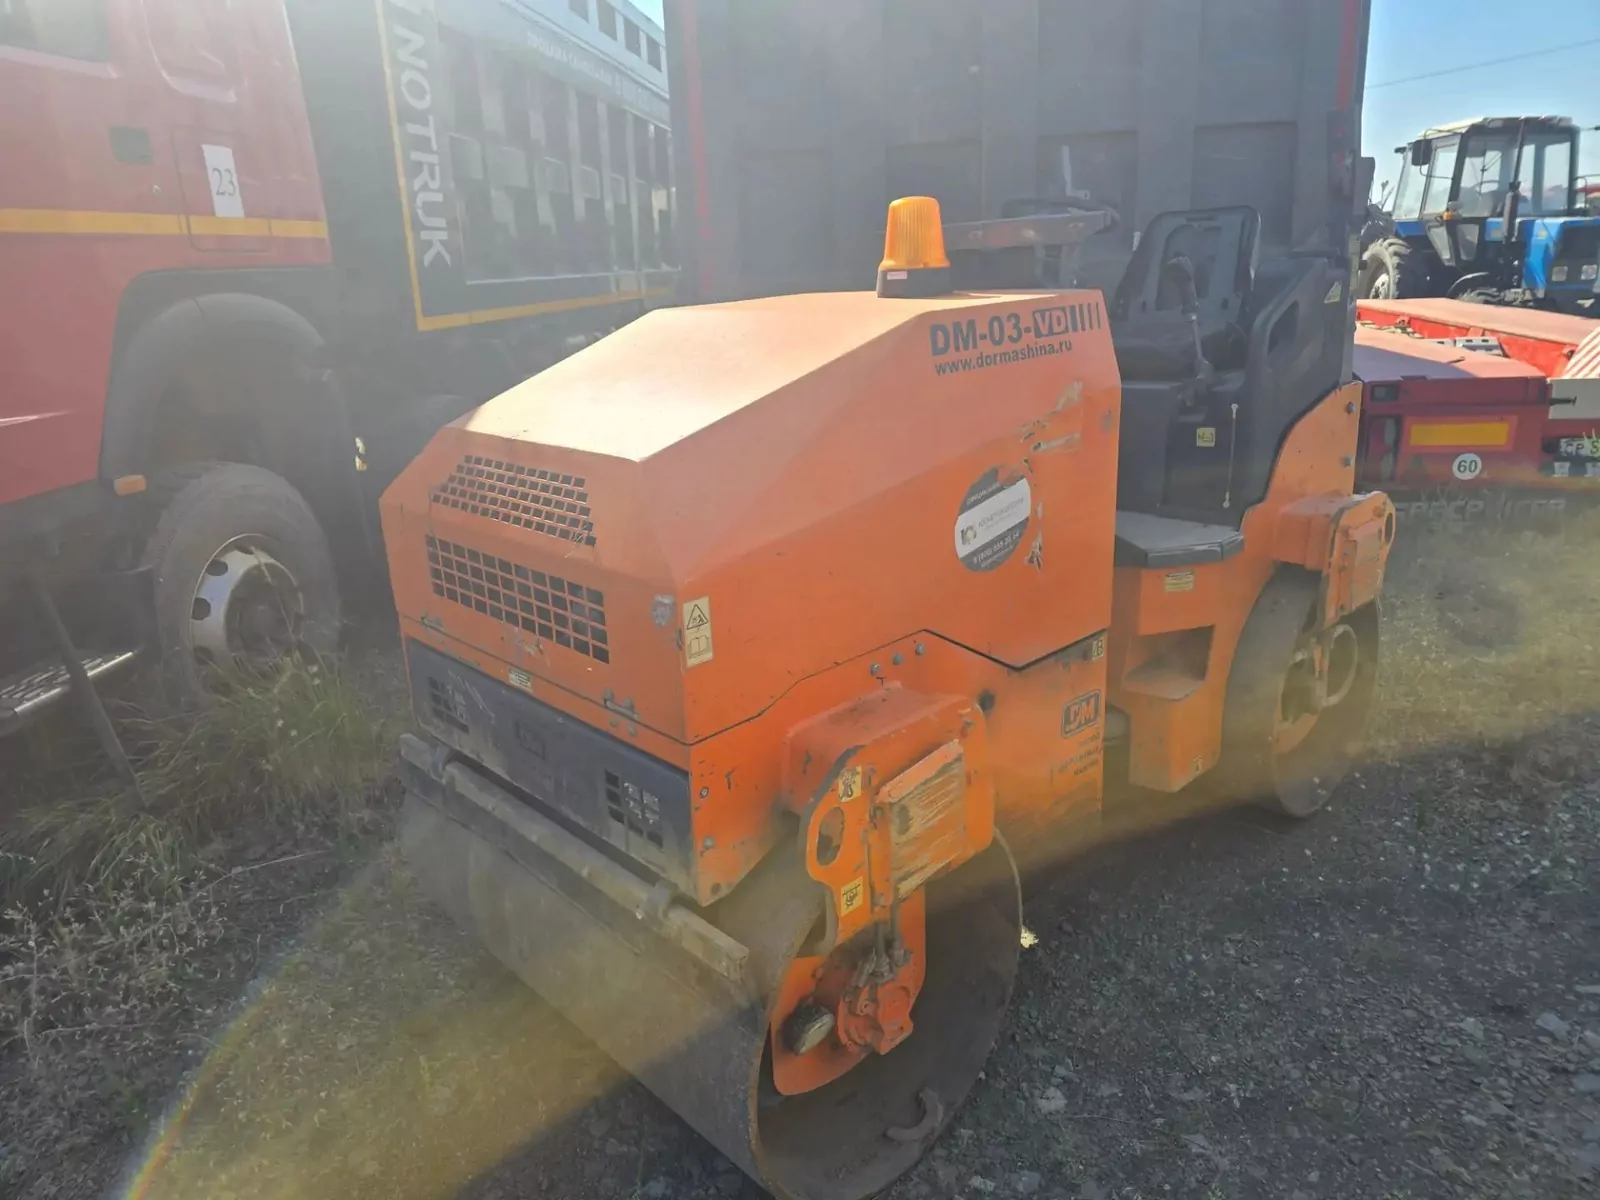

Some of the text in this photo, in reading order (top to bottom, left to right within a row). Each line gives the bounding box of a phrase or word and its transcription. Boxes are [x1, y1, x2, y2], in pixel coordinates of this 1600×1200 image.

[212, 167, 236, 197] 23
[935, 339, 1073, 376] www.dormashina.ru
[1457, 459, 1478, 474] 60
